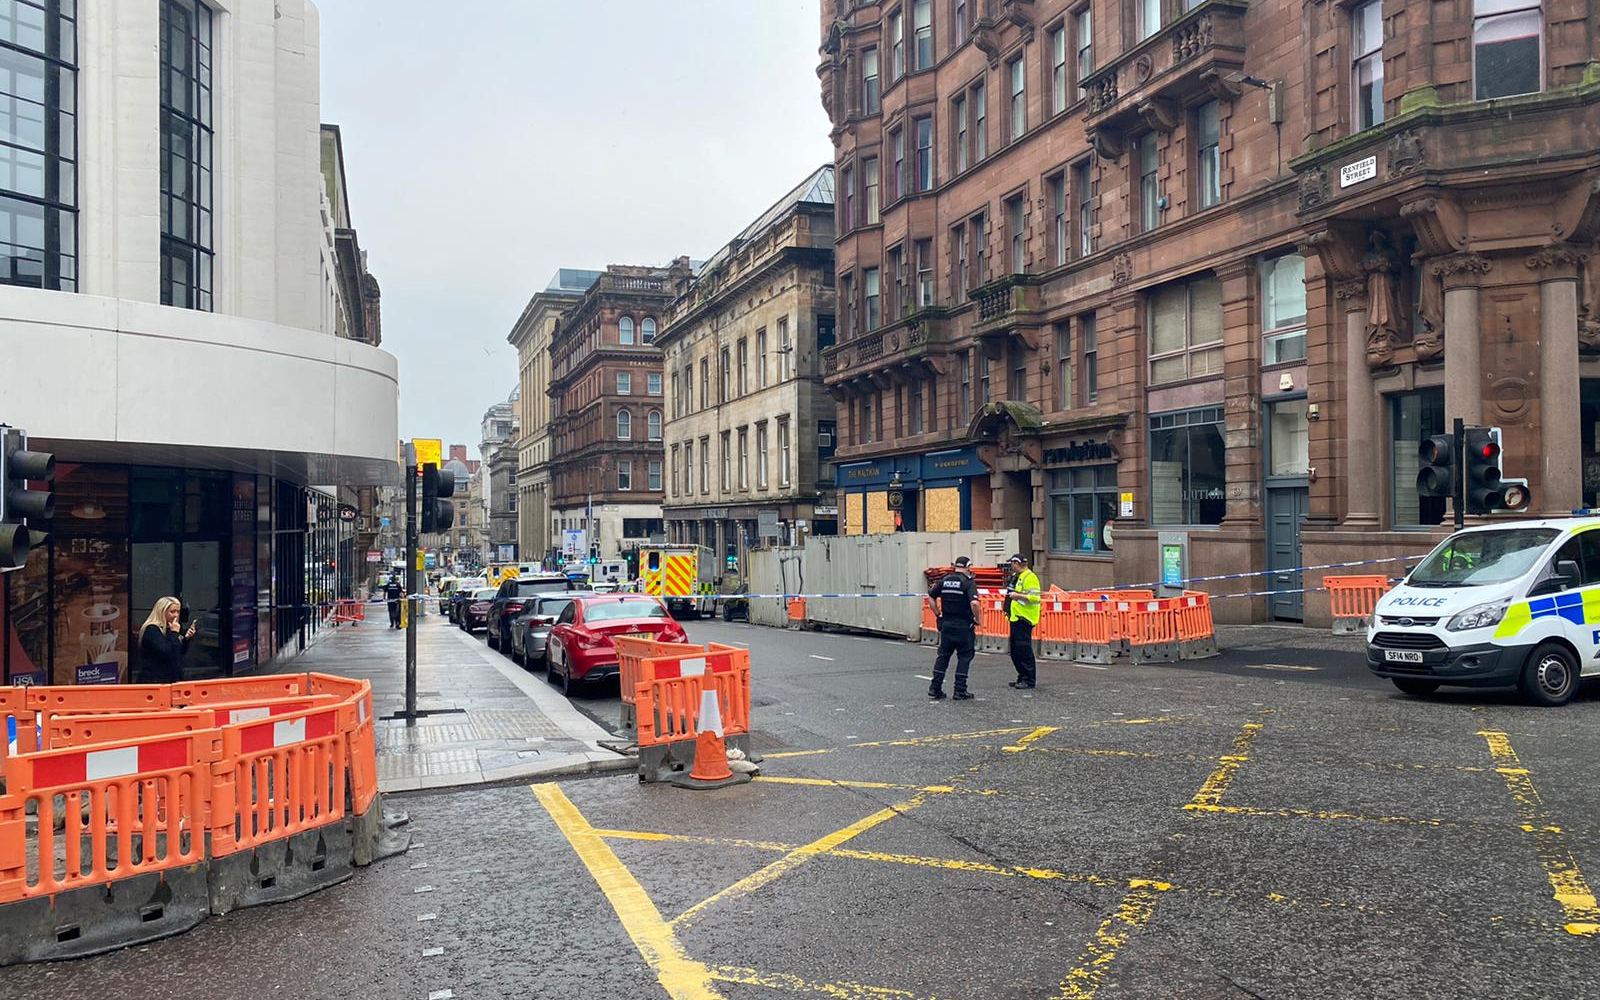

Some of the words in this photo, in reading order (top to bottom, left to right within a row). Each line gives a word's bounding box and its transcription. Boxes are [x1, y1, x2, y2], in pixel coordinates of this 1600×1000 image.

[1342, 159, 1375, 175] RENFIELD
[1345, 168, 1371, 181] STREET
[943, 580, 961, 588] POLICE
[1388, 597, 1448, 607] POLICE
[1389, 652, 1404, 660] SF14
[78, 667, 101, 678] breck
